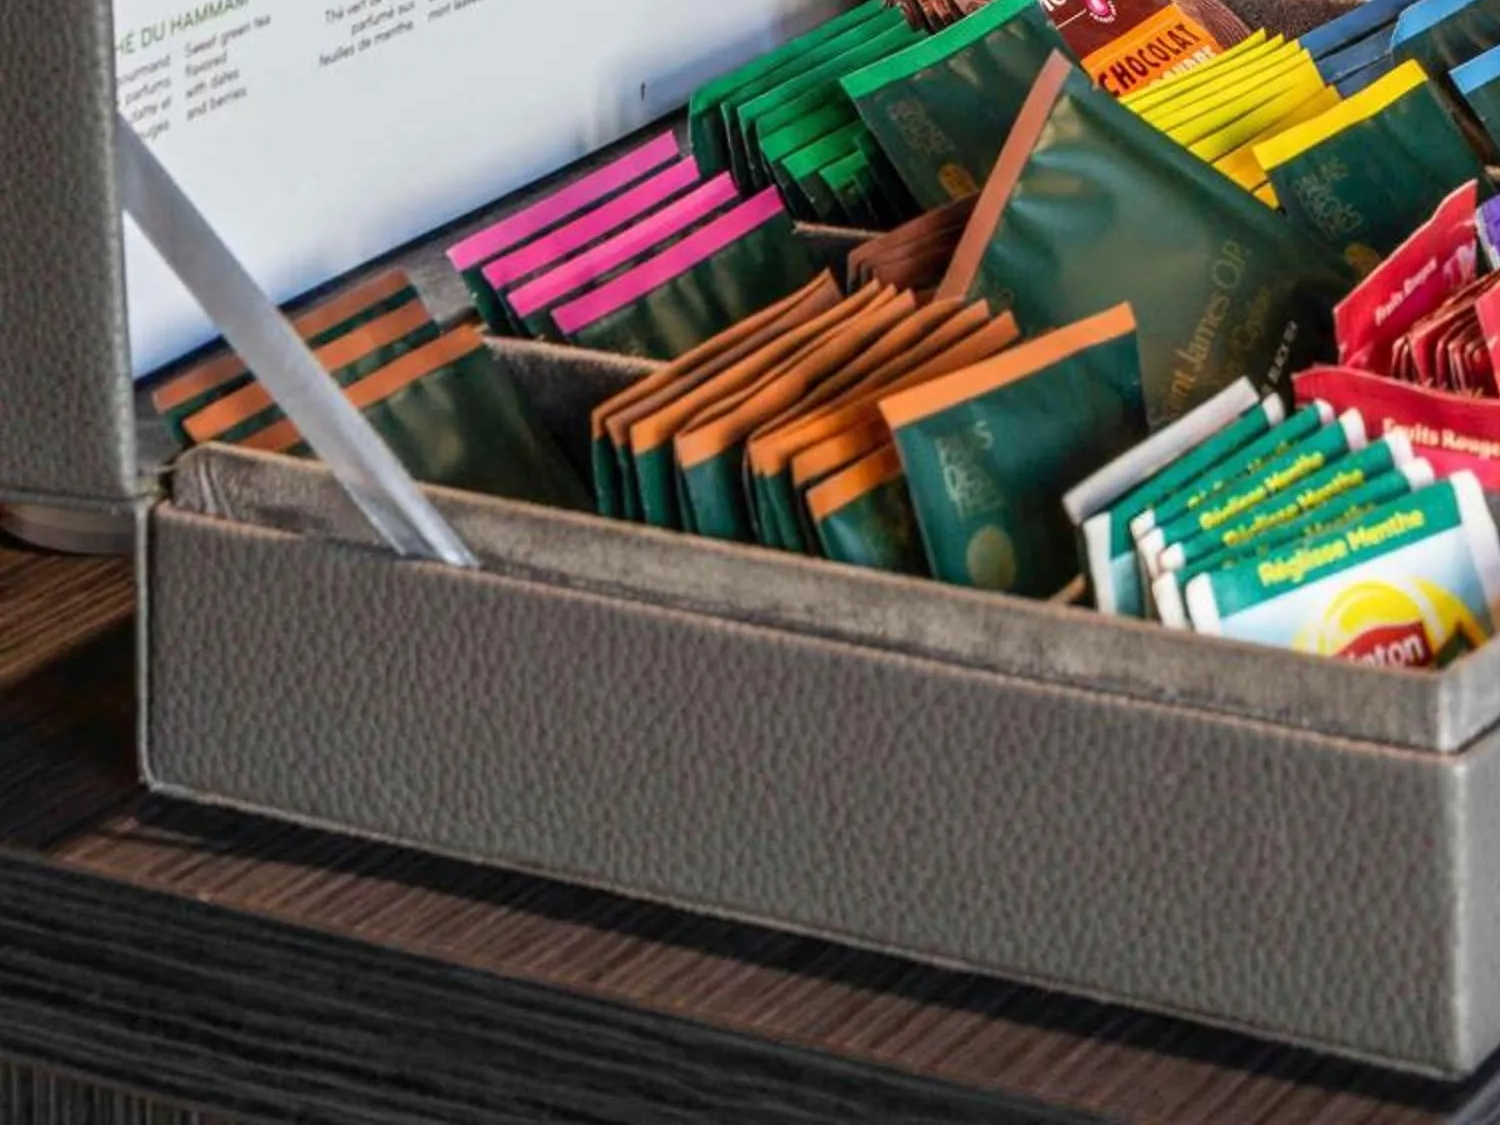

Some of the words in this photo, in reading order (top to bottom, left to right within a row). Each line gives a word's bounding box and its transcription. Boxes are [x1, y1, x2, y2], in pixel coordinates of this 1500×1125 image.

[141, 23, 165, 49] DU
[1098, 23, 1201, 97] CHOCOLAT
[1346, 509, 1425, 551] Menthe
